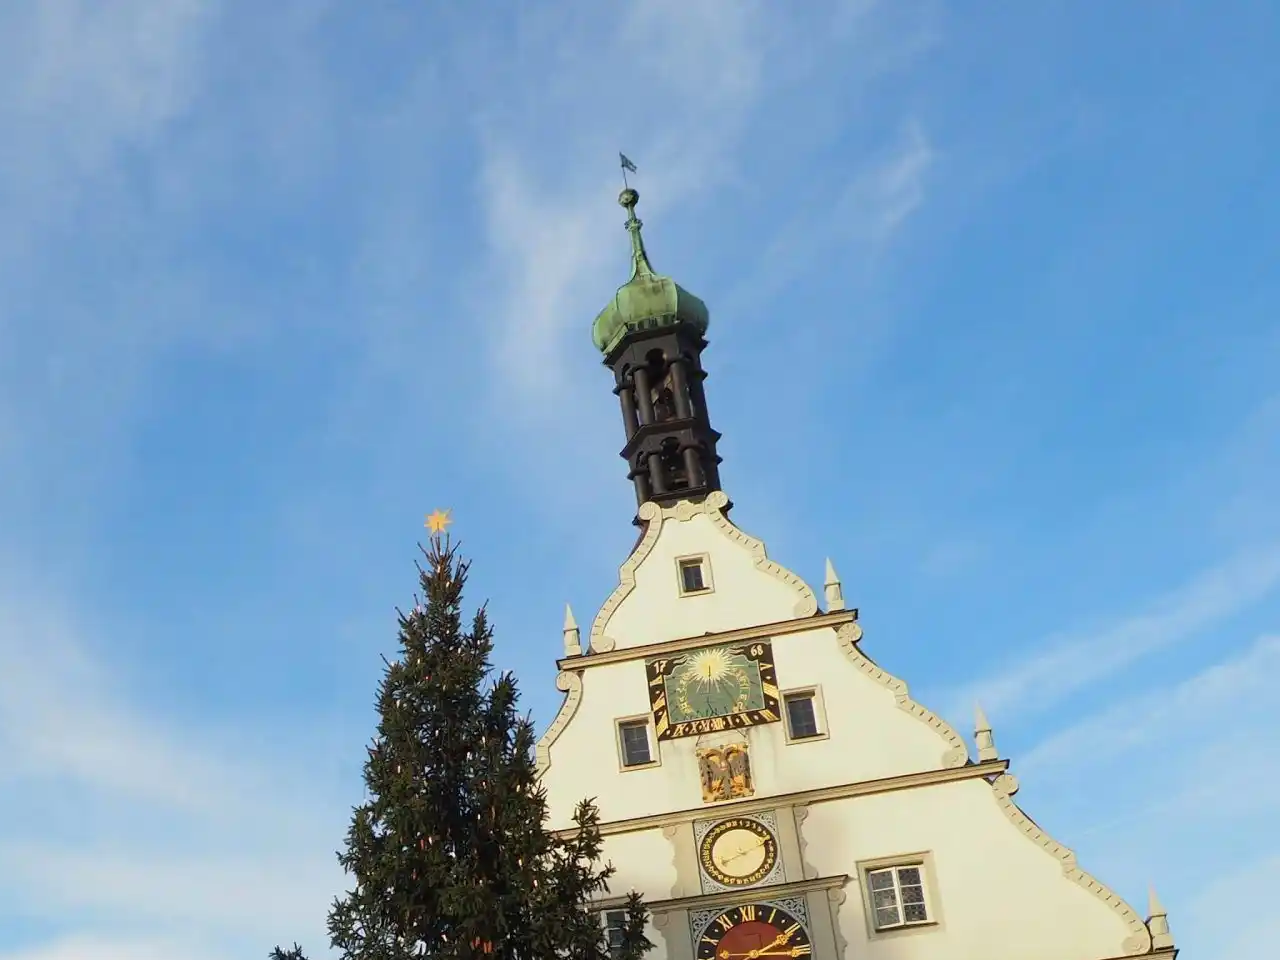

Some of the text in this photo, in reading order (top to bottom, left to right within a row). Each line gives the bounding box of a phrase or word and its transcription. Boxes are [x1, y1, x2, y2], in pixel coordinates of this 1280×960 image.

[750, 644, 764, 657] 68
[653, 660, 668, 674] 17
[739, 905, 755, 922] XII
[768, 908, 777, 924] I
[716, 913, 734, 932] XI
[701, 935, 719, 946] X
